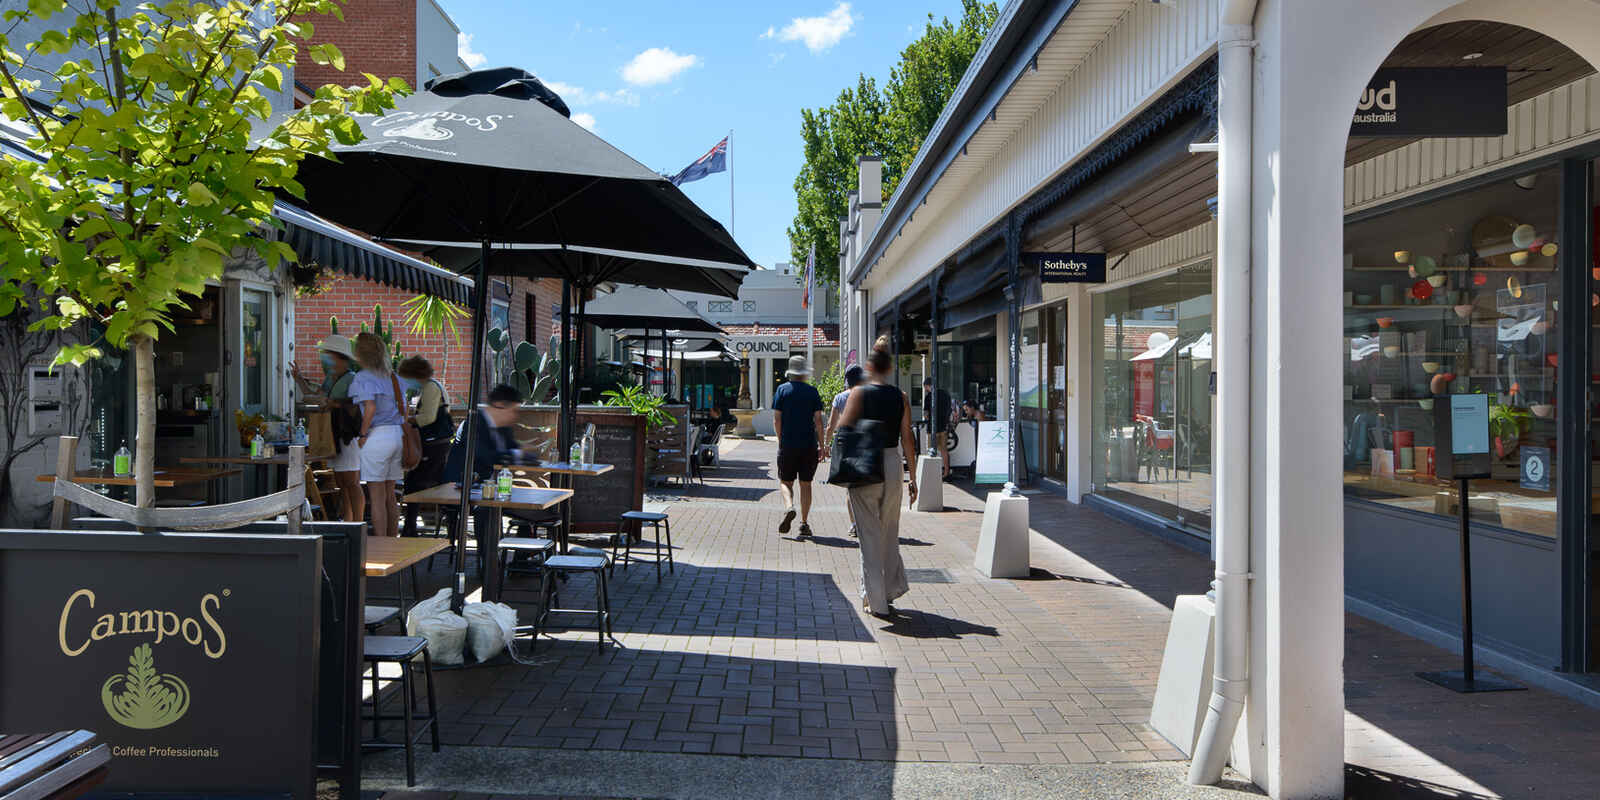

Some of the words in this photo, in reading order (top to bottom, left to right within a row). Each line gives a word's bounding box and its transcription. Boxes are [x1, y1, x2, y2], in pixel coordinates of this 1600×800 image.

[1358, 80, 1396, 110] ud
[1354, 112, 1396, 123] australia
[1044, 260, 1087, 271] Sotheby's
[735, 341, 787, 353] COUNCIL
[112, 745, 146, 757] Coffee
[149, 745, 219, 758] Professionals
